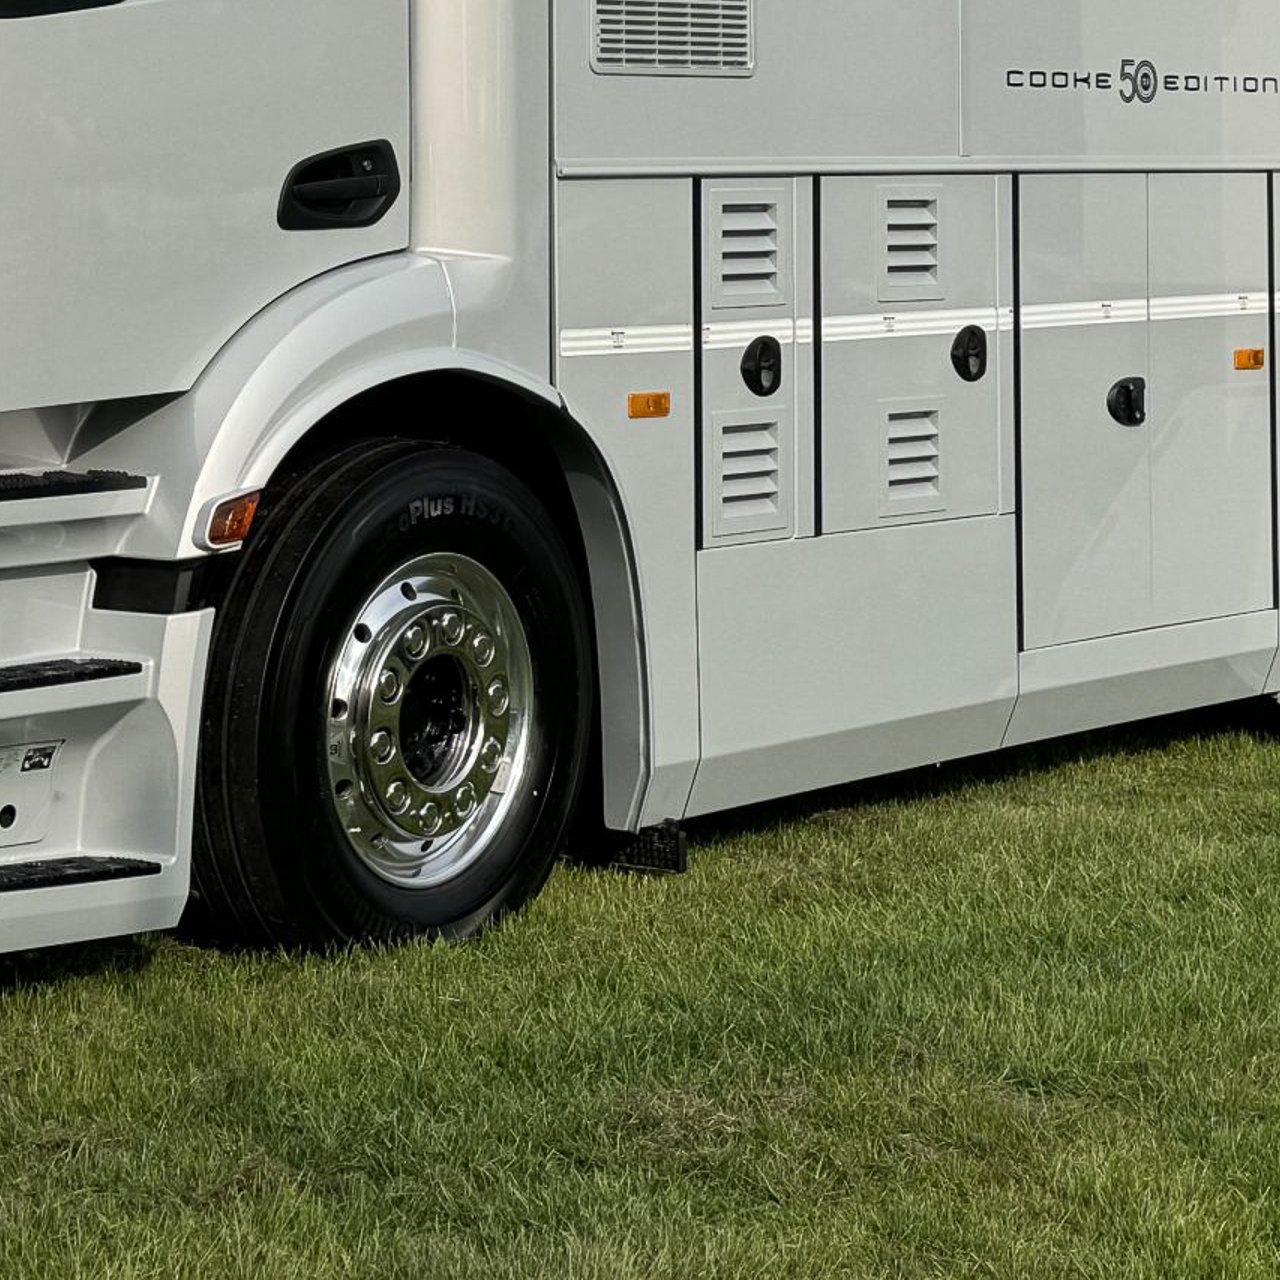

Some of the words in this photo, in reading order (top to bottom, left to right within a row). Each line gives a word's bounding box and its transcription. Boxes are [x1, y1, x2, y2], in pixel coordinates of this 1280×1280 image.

[1006, 69, 1112, 90] COOKE
[1119, 58, 1158, 104] 50
[1163, 74, 1279, 94] EDITION
